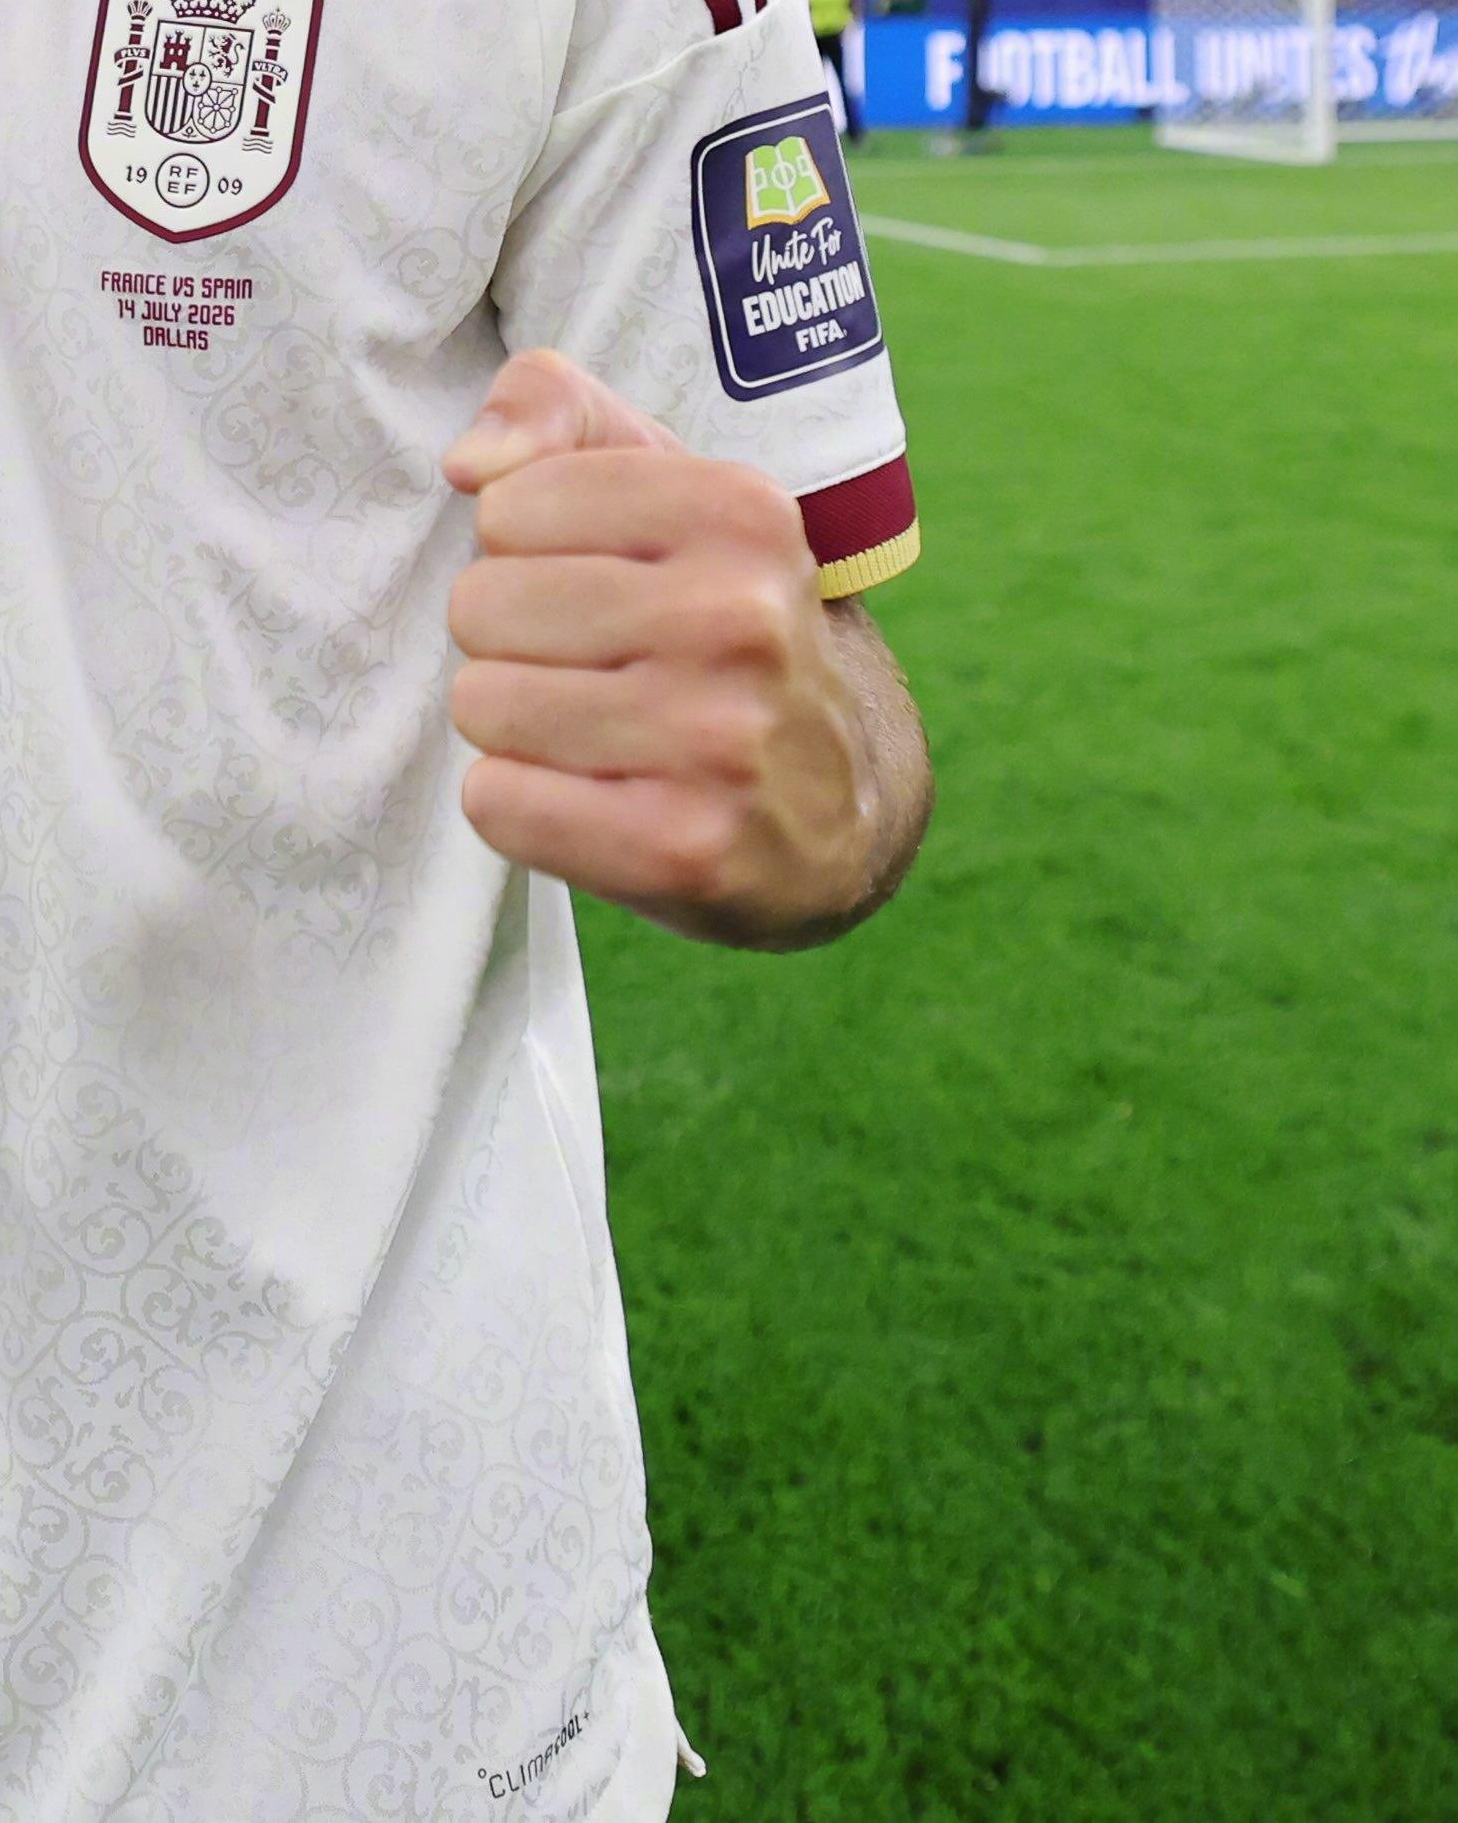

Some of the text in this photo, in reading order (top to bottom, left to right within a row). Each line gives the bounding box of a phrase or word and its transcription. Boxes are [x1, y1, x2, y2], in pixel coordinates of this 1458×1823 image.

[125, 164, 148, 184] 19
[217, 176, 243, 196] 09
[751, 216, 842, 285] Unite For
[101, 271, 253, 299] FRANCE VS SPAIN
[742, 260, 866, 337] EDUCATION
[117, 298, 235, 327] 14 JULY 2026
[143, 325, 209, 351] DALLAS
[795, 318, 846, 353] FIFA
